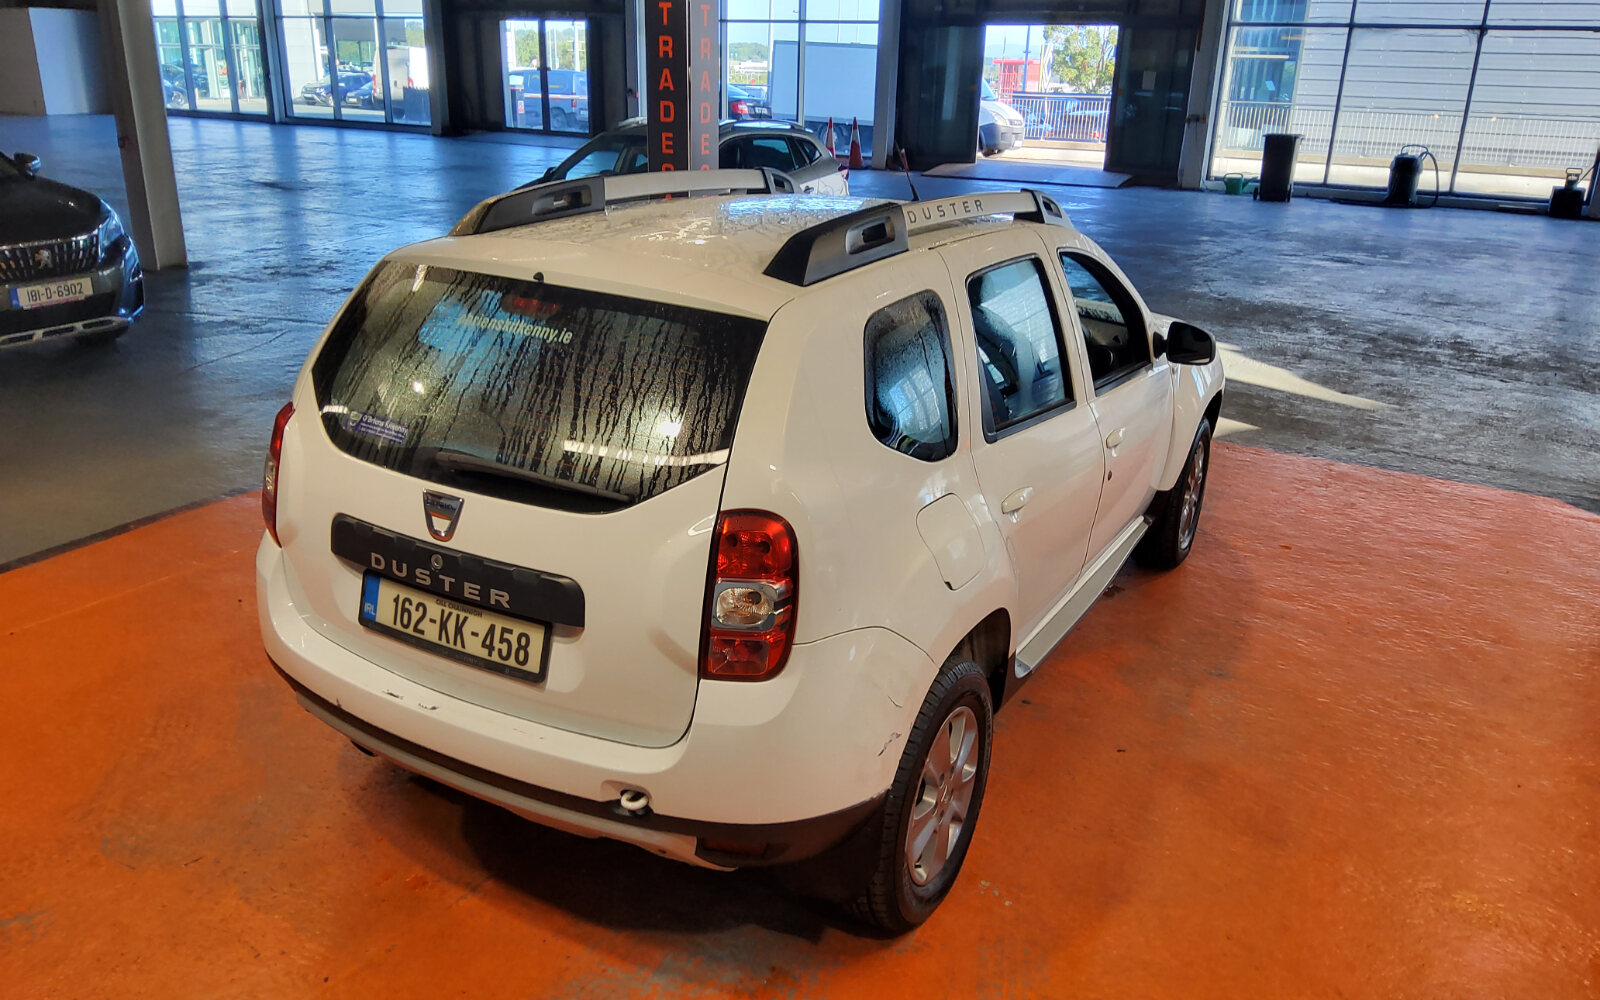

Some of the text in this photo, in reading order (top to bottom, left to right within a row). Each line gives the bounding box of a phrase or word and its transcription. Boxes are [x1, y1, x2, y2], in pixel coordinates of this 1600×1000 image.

[907, 199, 984, 224] DUSTER
[26, 282, 84, 303] 181-D-6902
[370, 552, 511, 609] DUSTER
[364, 602, 376, 616] IRL
[392, 593, 531, 667] 162-KK-458
